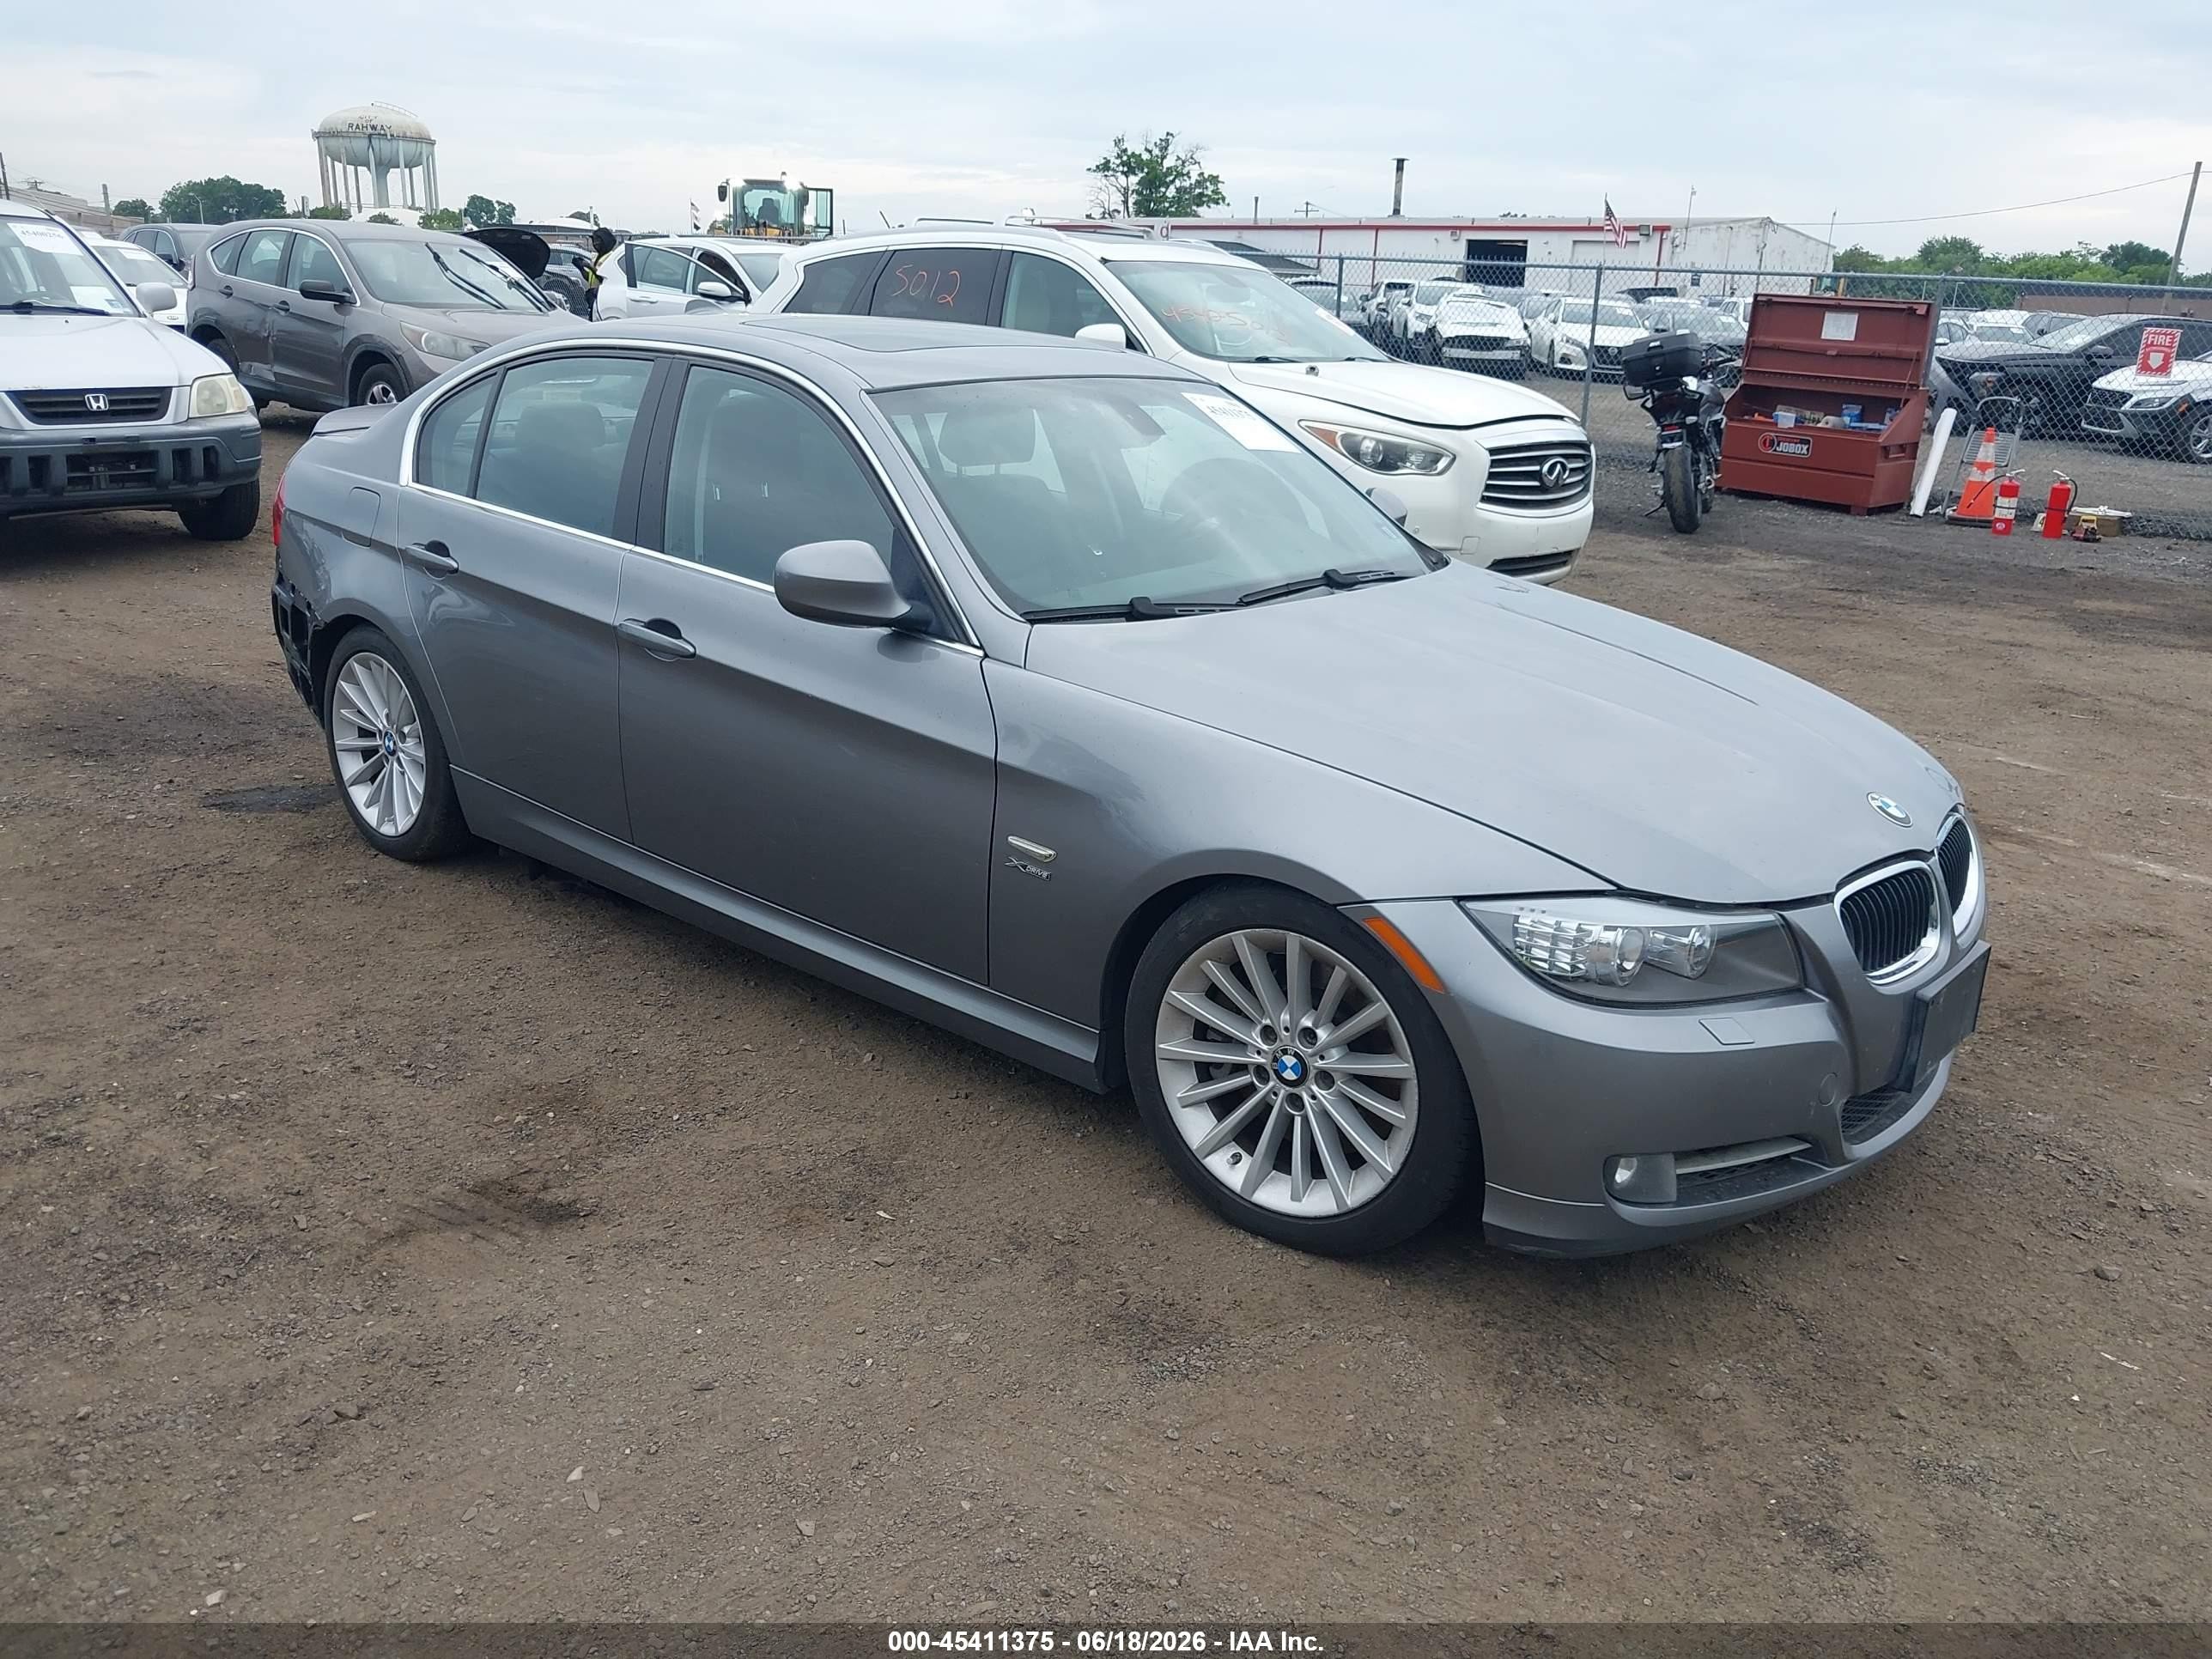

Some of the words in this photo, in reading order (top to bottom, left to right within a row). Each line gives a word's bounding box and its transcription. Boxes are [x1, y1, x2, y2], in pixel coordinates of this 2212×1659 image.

[348, 122, 392, 131] RAHWAY
[892, 263, 961, 307] 5012
[2148, 334, 2173, 346] FIRE
[1776, 441, 1809, 455] JOBOX
